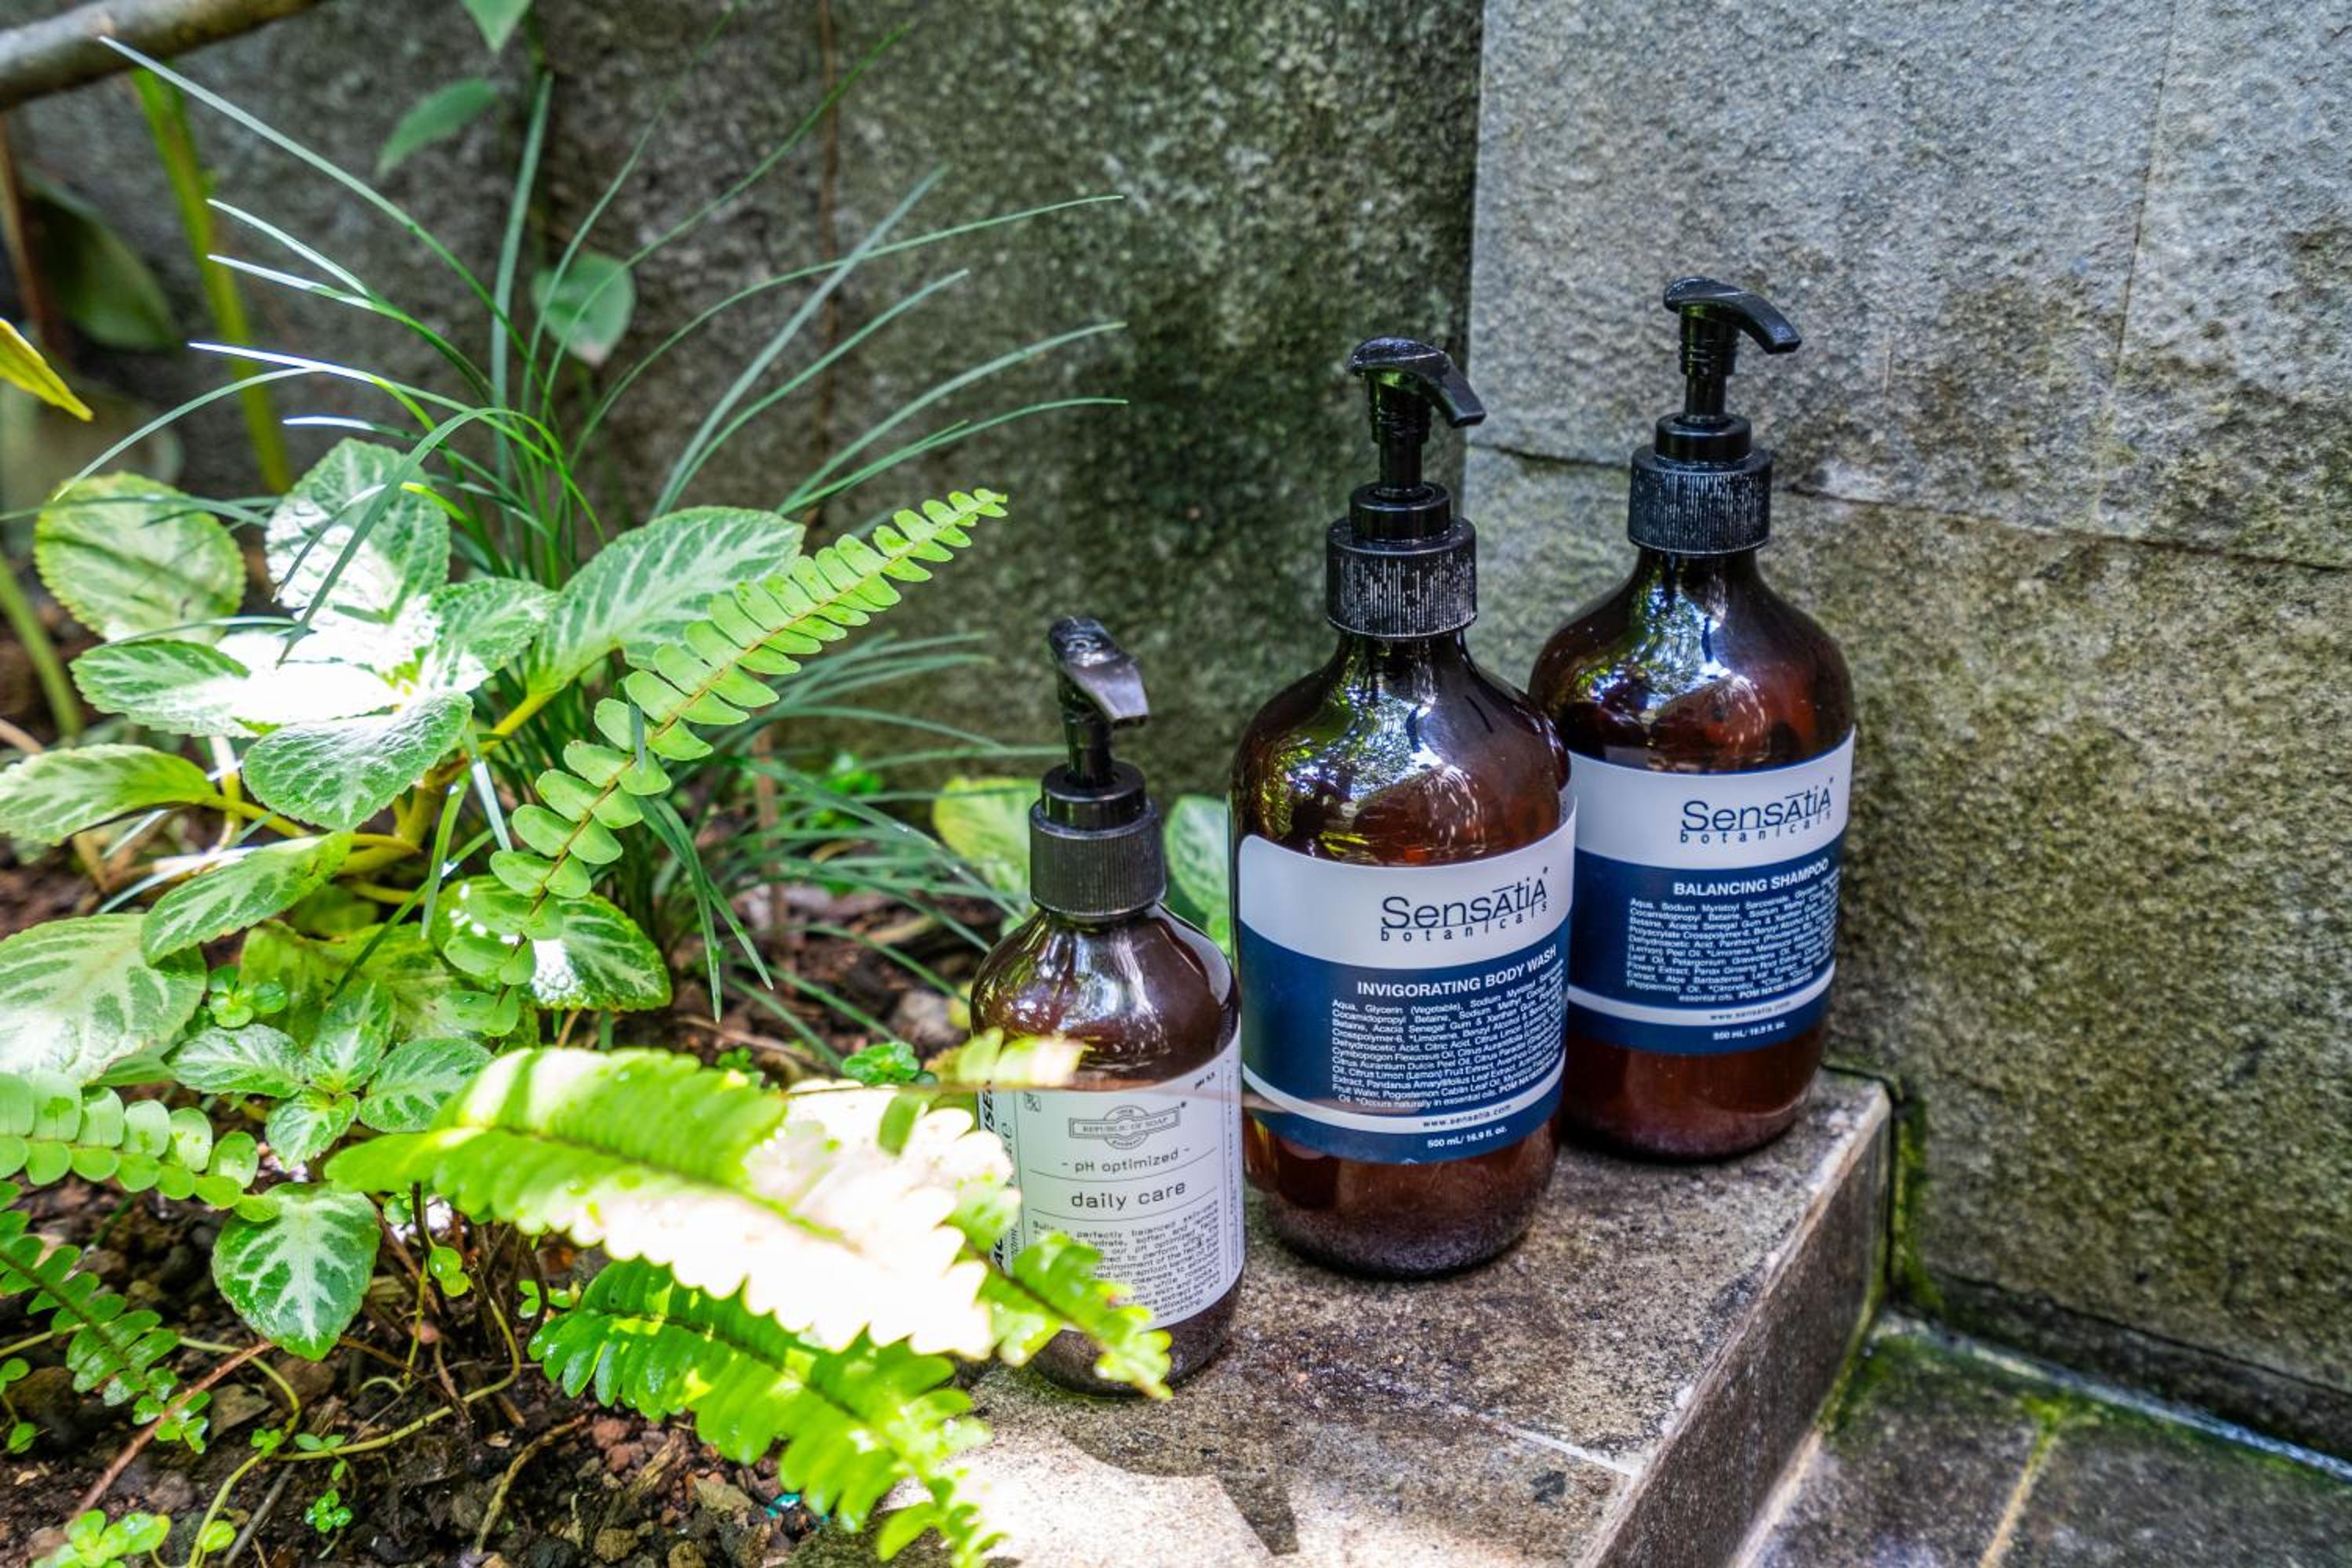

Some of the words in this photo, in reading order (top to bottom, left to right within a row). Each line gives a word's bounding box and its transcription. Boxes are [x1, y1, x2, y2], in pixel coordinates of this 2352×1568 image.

[1680, 808, 1831, 844] botanicals
[1675, 878, 1767, 895] BALANCING
[1771, 857, 1828, 889] SHAMPOO
[1381, 899, 1547, 942] botanicals
[1357, 976, 1480, 996] INVIGORATING
[1485, 961, 1524, 988] BODY
[1526, 943, 1555, 973] WASH
[1365, 1004, 1403, 1015] Glycerin
[1470, 993, 1501, 1008] Sodium
[1414, 1014, 1450, 1023] Betaine,
[1459, 1005, 1491, 1018] Sodium
[1408, 1024, 1444, 1034] Senegal
[1450, 1020, 1471, 1030] Gum
[1462, 1025, 1490, 1039] Benzyl
[1333, 1037, 1396, 1051] Dehydroacetic
[1425, 1042, 1448, 1051] Citric
[1474, 1032, 1497, 1045] Citrus
[1333, 1046, 1392, 1062] Cymbopogon
[1457, 1045, 1482, 1057] Citrus
[1359, 1060, 1405, 1070] Aurantium
[1367, 1080, 1410, 1089] Pandanus
[1472, 1072, 1489, 1083] Leaf
[1376, 1071, 1403, 1080] Limon
[1406, 1070, 1442, 1080] (Lemon)
[1443, 1092, 1479, 1105] essential
[1422, 1104, 1512, 1127] www.sensatia.com
[1427, 1138, 1445, 1149] 500
[1466, 1131, 1485, 1142] 16.9
[1075, 1162, 1094, 1173] pH
[1102, 1148, 1178, 1174] optimized
[1071, 1192, 1127, 1211] daily
[1138, 1181, 1186, 1205] care
